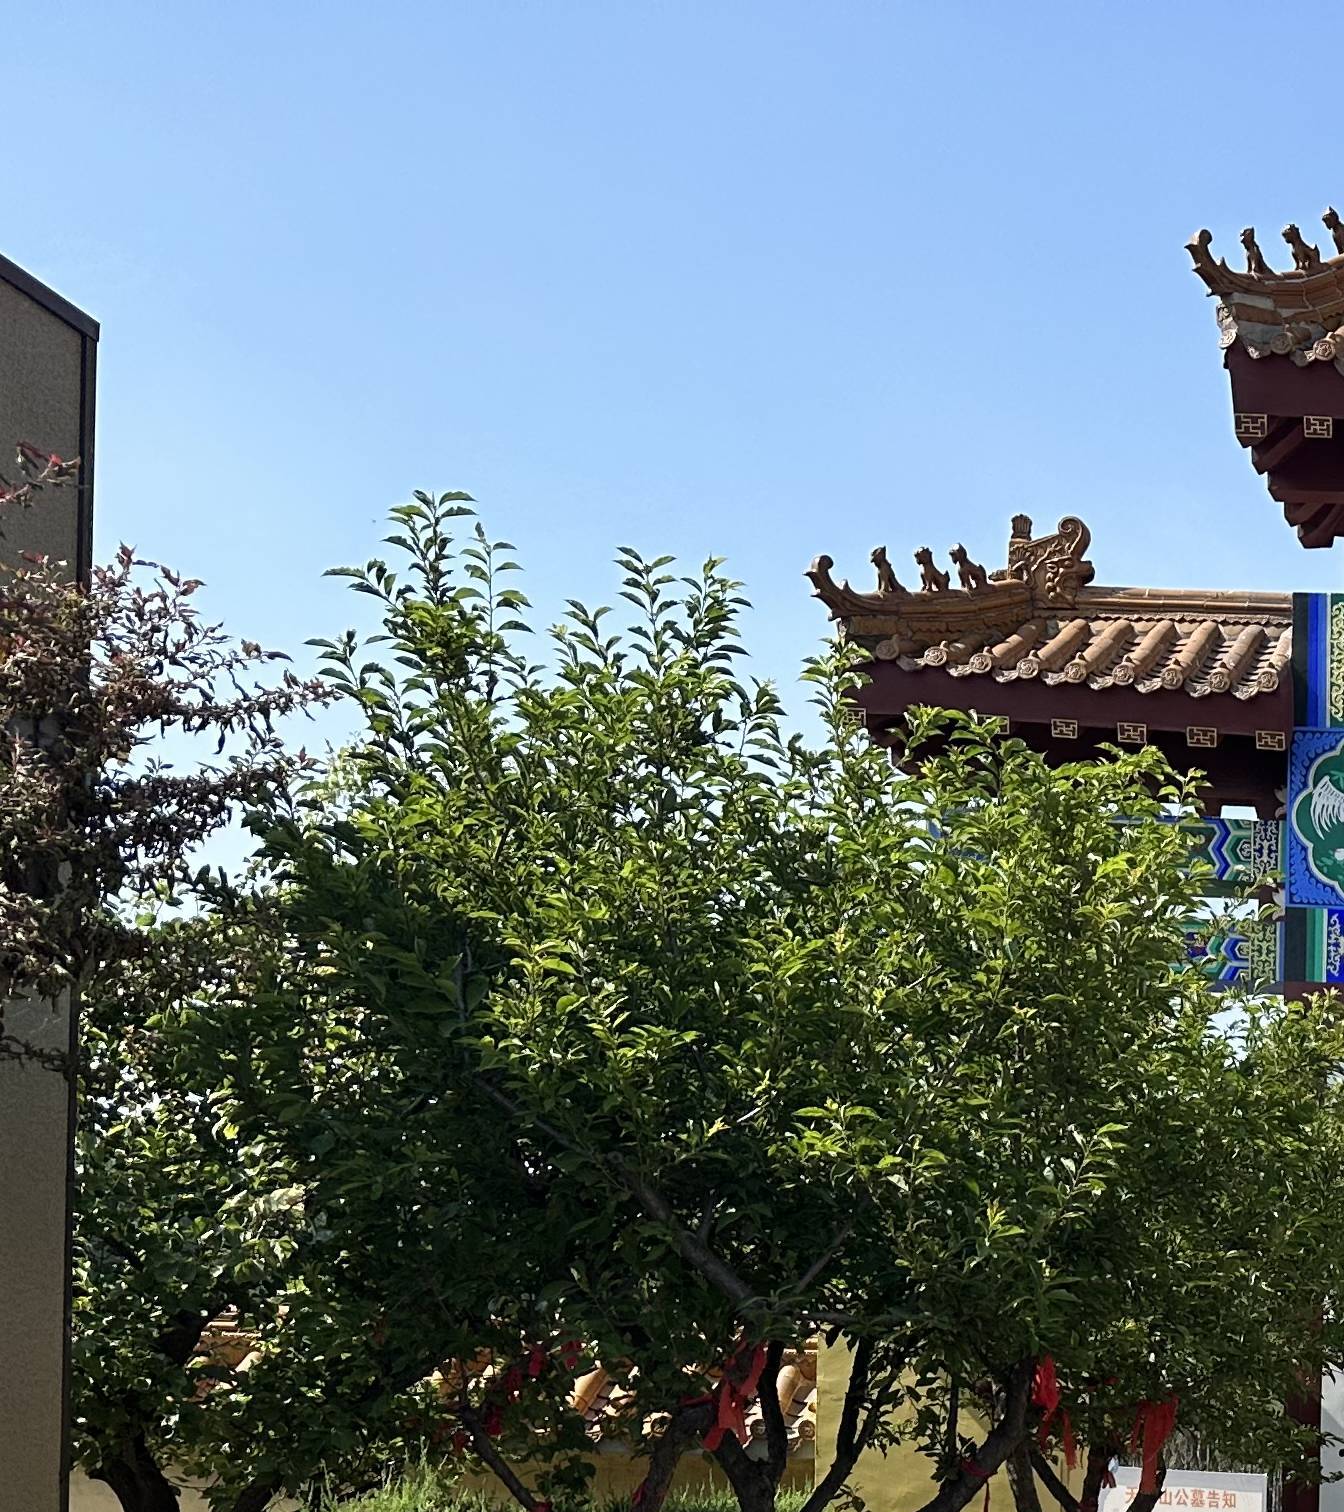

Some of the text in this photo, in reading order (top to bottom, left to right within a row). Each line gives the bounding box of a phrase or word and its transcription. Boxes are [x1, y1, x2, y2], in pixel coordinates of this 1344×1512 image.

[1124, 1487, 1237, 1509] 天山公墓告知
